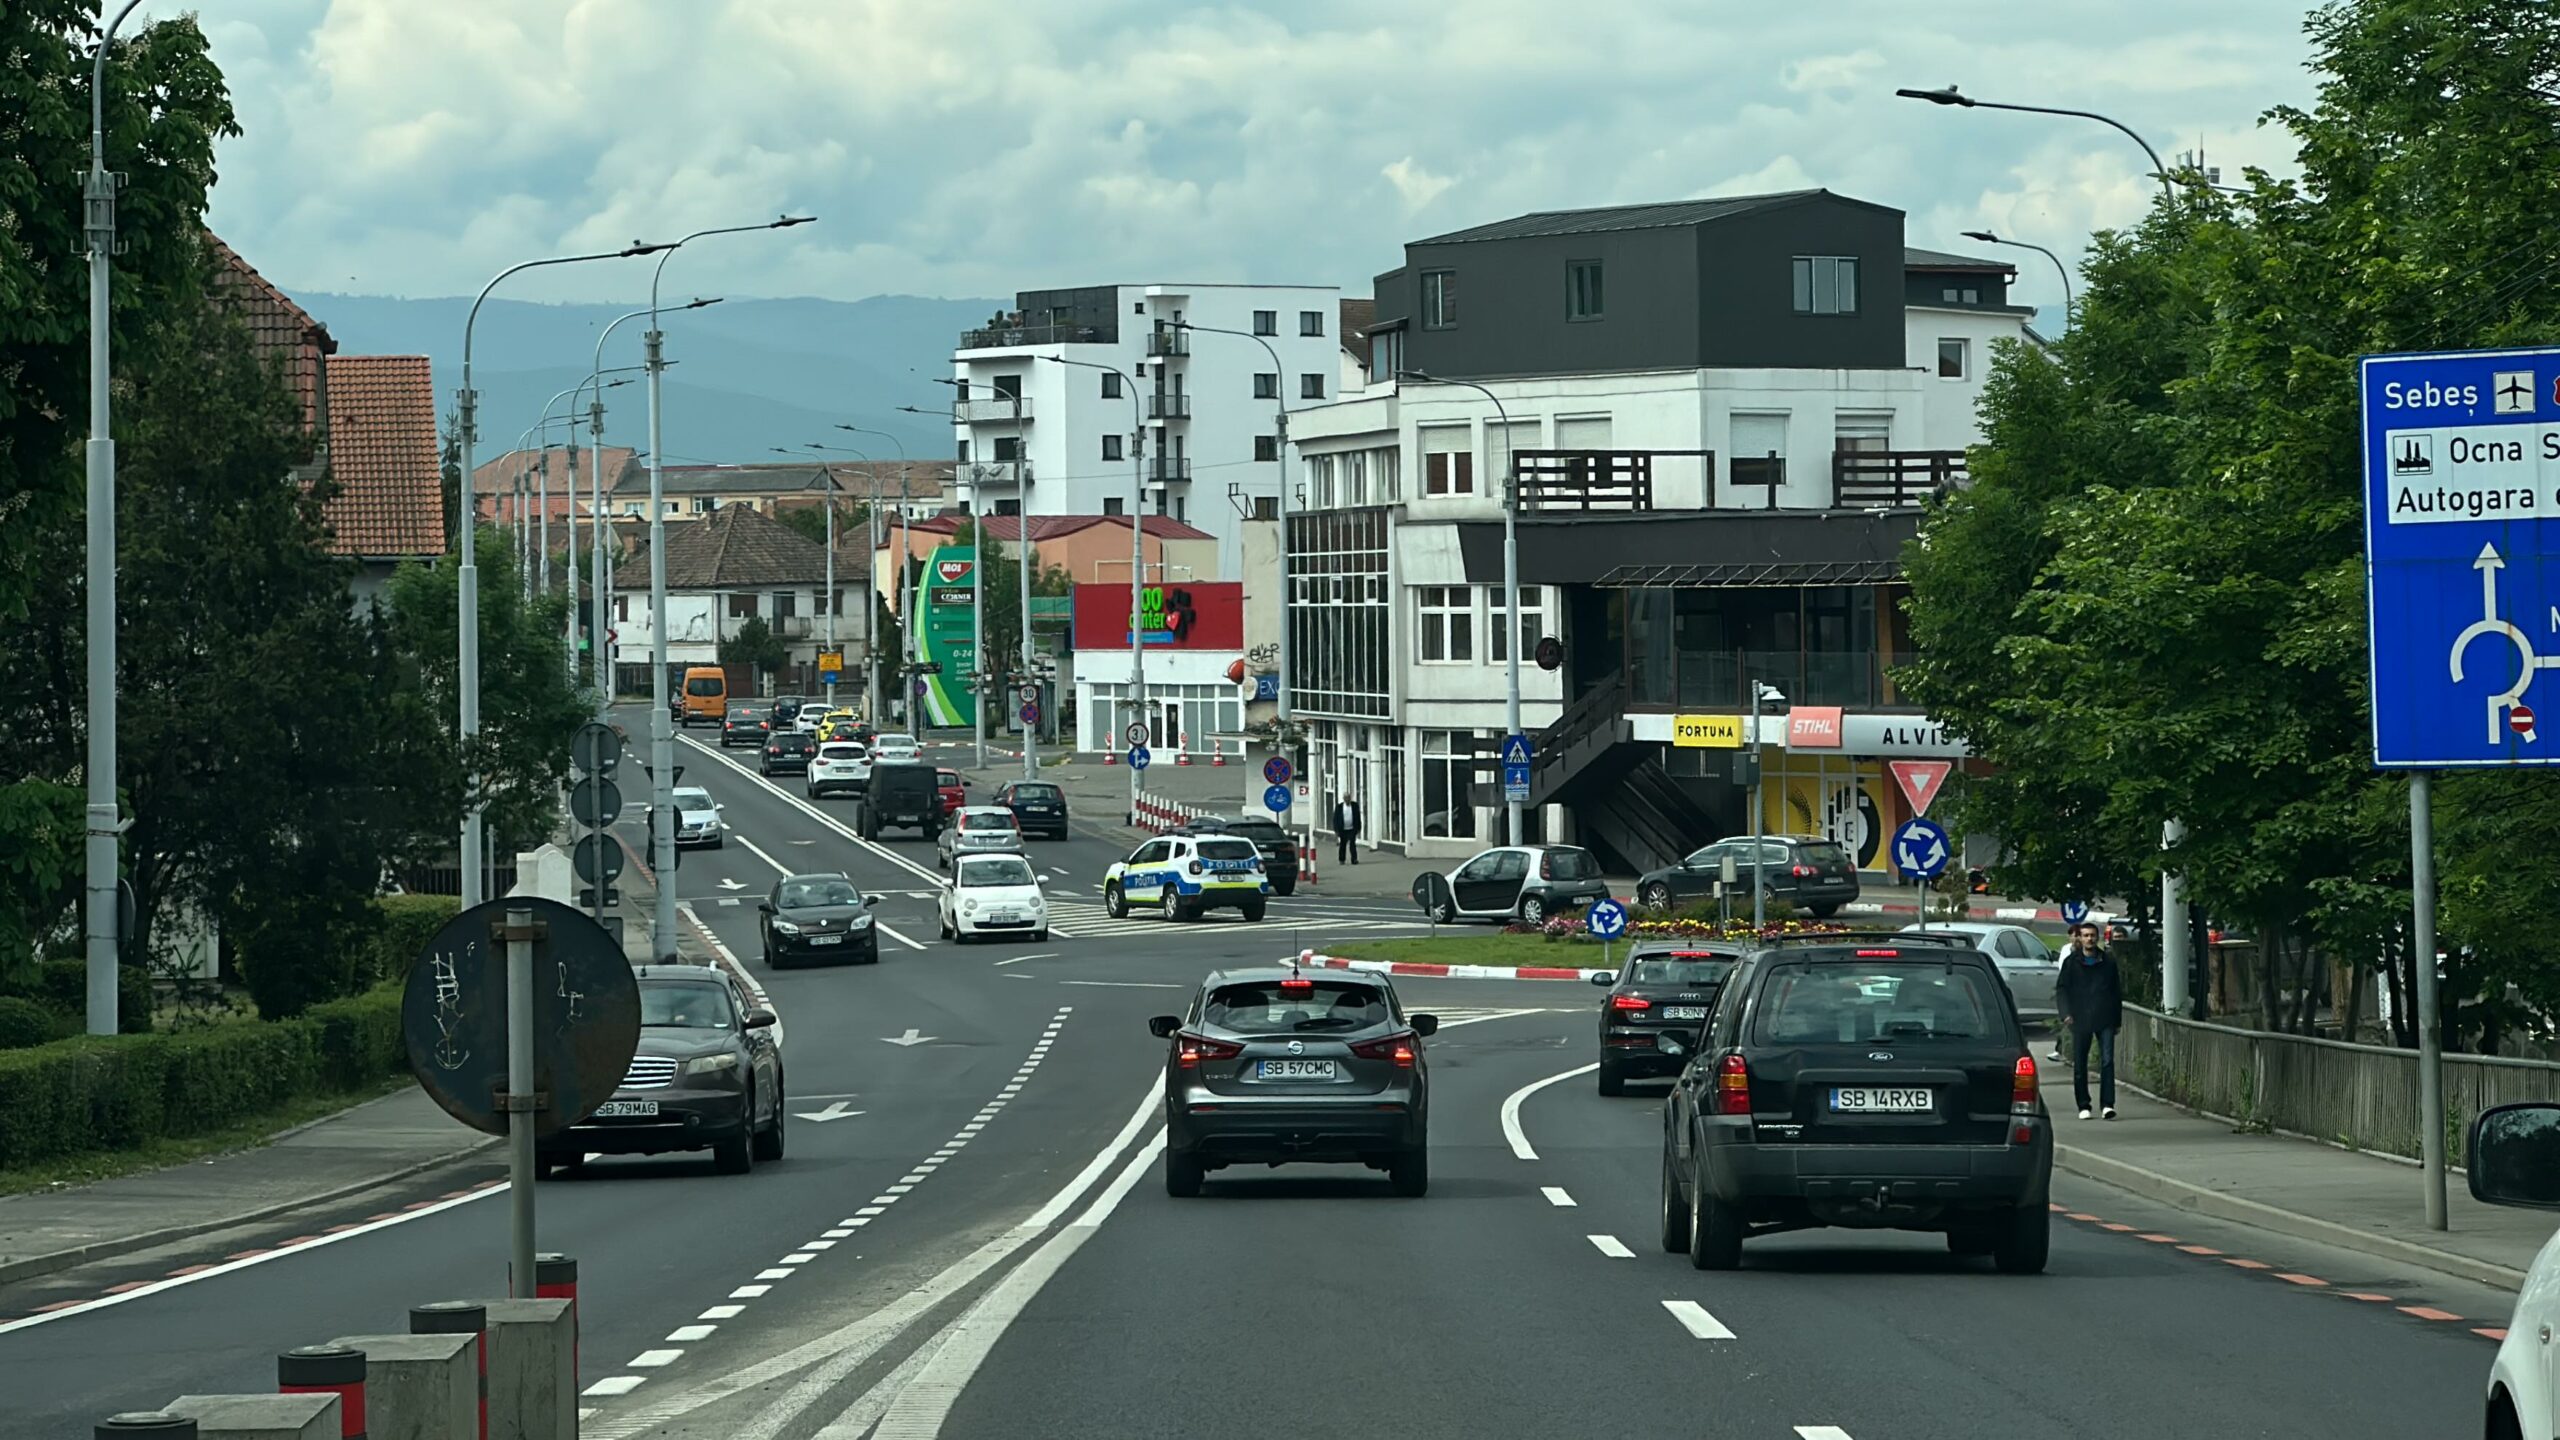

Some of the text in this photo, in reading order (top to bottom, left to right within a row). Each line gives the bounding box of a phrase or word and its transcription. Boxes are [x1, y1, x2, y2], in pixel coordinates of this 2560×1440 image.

[2385, 381, 2478, 416] Sebeș
[2450, 437, 2522, 463] Ocna
[2396, 486, 2534, 517] Autogara
[1023, 688, 1034, 699] 30
[1678, 725, 1734, 738] FORTUNA
[1792, 719, 1833, 734] STIHL
[1667, 1007, 1680, 1016] SB
[1265, 1062, 1333, 1075] SB 57CMC
[1841, 1090, 1928, 1107] SB 14RXB
[598, 1102, 657, 1115] SB 79MAG
